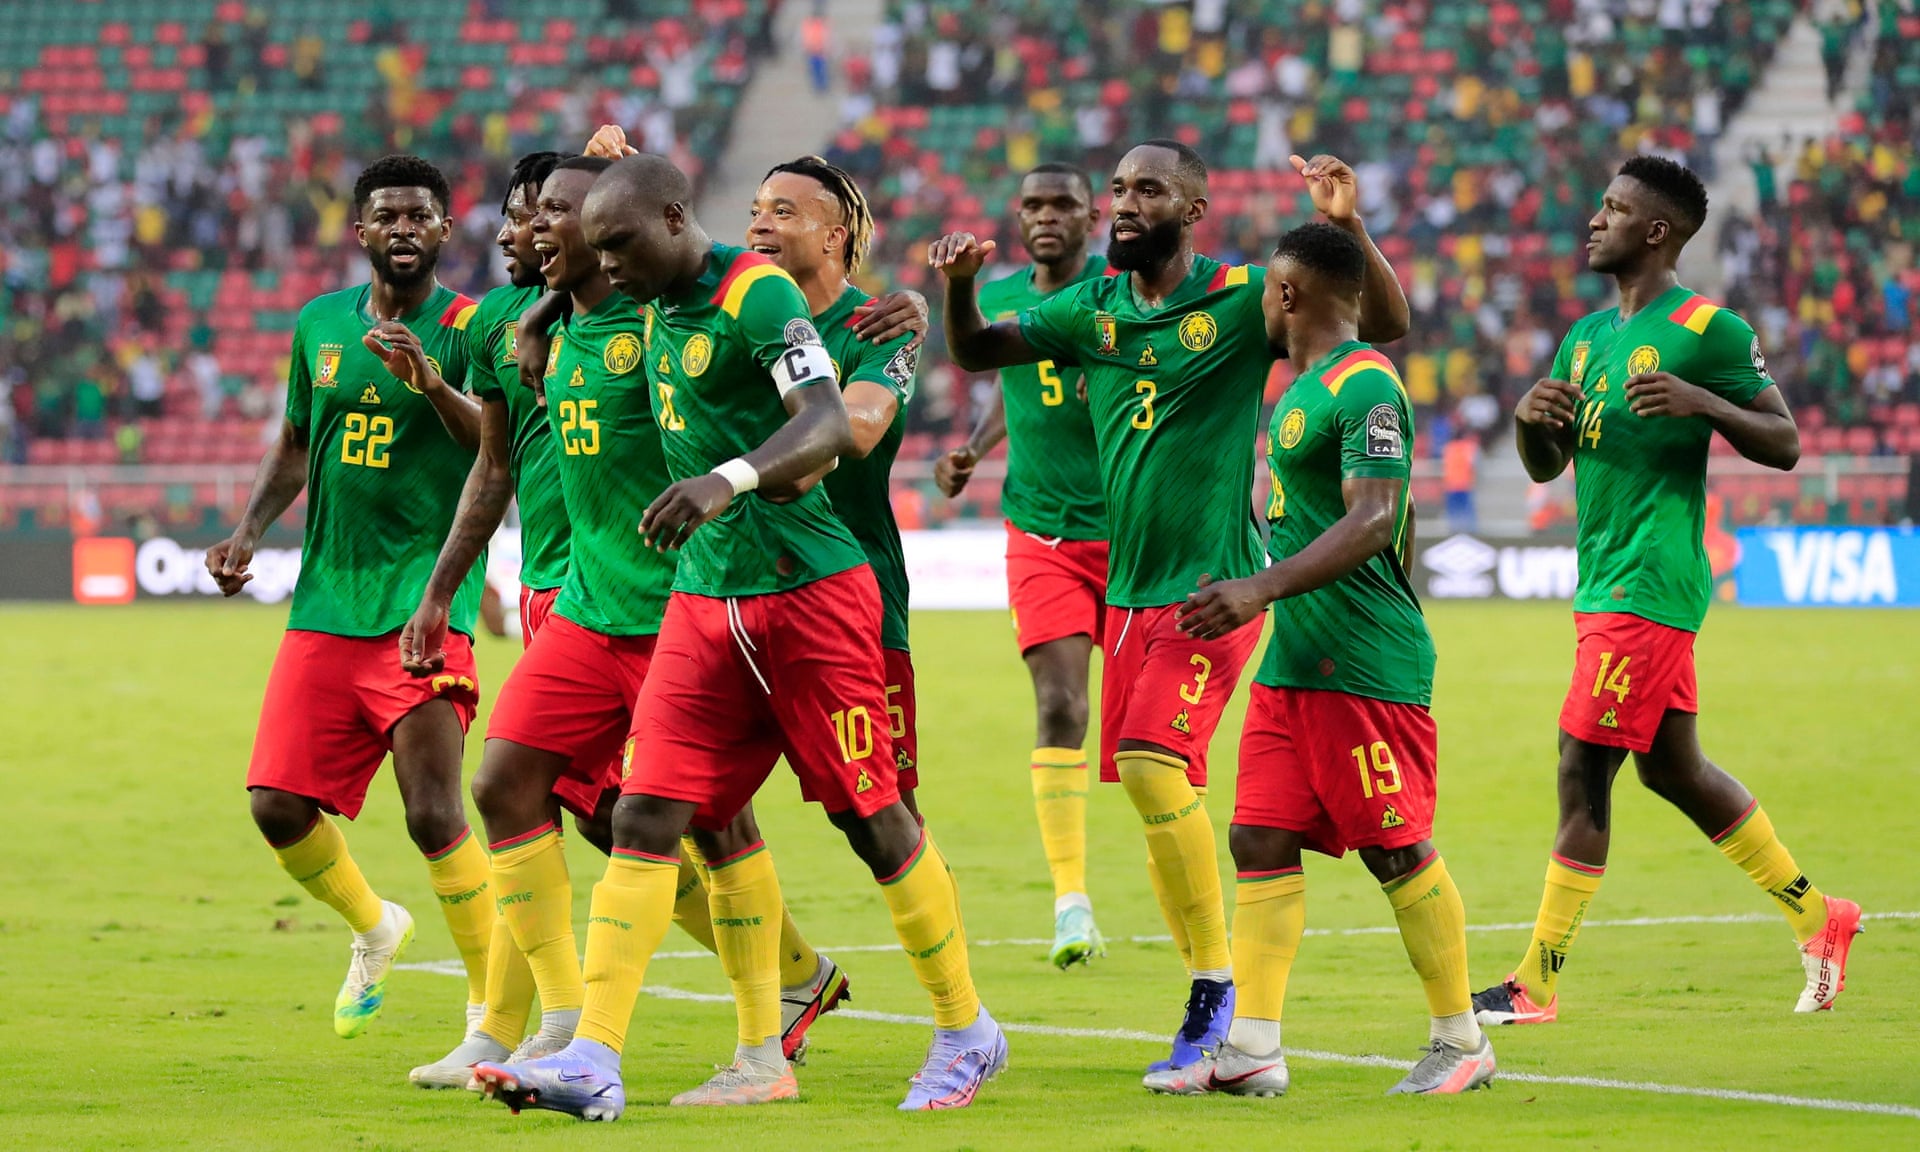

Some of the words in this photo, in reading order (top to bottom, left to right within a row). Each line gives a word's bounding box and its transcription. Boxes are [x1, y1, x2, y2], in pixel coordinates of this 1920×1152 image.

[785, 348, 811, 382] C
[1037, 360, 1064, 406] 5
[559, 400, 599, 456] 25
[1132, 380, 1157, 430] 3
[1579, 400, 1605, 449] 14
[341, 412, 394, 468] 22
[1767, 530, 1898, 603] VISA
[1179, 653, 1212, 705] 3
[1592, 652, 1631, 703] 14
[831, 706, 873, 764] 10
[1352, 741, 1402, 798] 19
[713, 916, 763, 926] SPORTIF
[1819, 918, 1839, 982] SPEED
